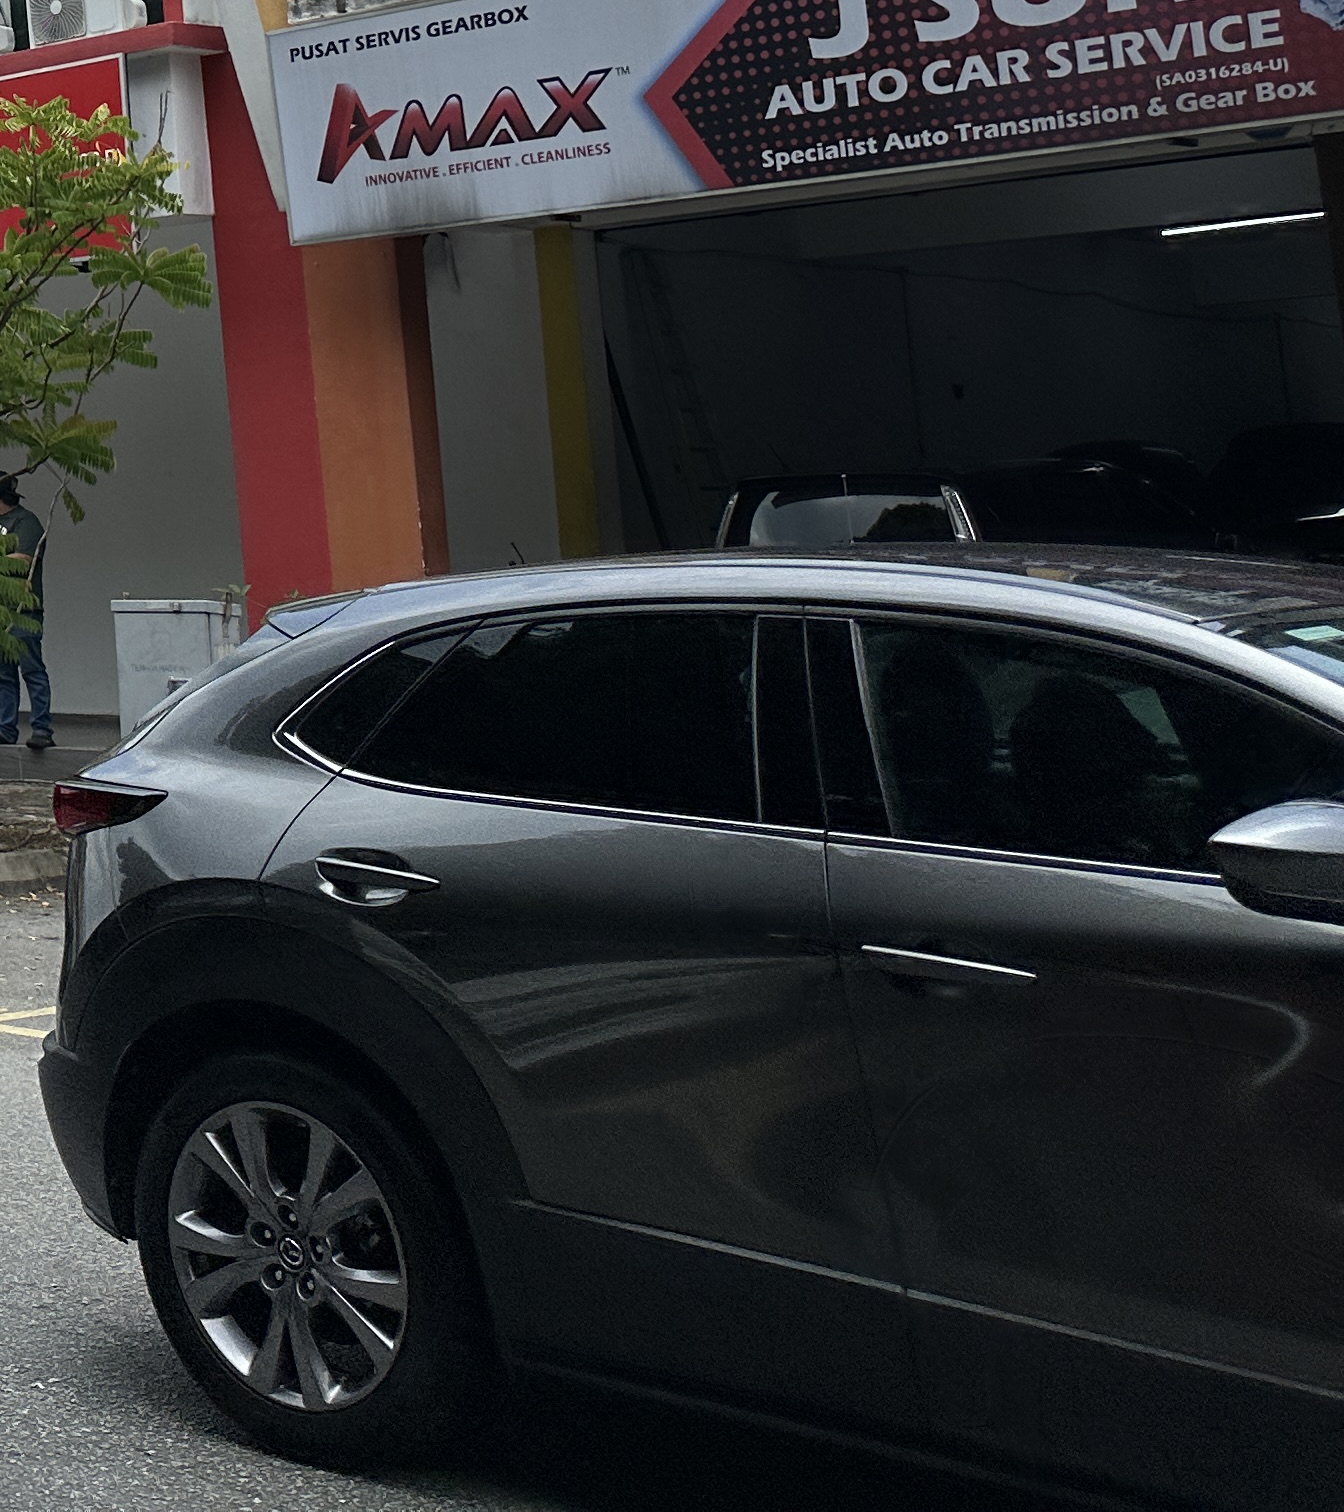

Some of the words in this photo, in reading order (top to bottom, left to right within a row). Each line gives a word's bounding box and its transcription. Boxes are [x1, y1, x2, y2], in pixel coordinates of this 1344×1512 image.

[289, 37, 350, 63] PUSAT
[354, 25, 422, 52] SERVIS
[425, 5, 530, 39] GEARBOX
[764, 67, 909, 120] AUTO
[920, 48, 1031, 96] CAR
[1045, 8, 1286, 79] SERVICE
[1155, 56, 1290, 90] (SA0316284-U)
[316, 67, 613, 185] AMAX
[761, 136, 878, 172] Specialist
[882, 127, 949, 153] Auto
[953, 101, 1140, 144] Transmission
[1146, 96, 1169, 117] &
[1175, 87, 1247, 115] Gear
[1253, 79, 1317, 104] Box
[364, 165, 441, 188] INNOVATIVE
[447, 156, 512, 176] EFFICIENT
[520, 141, 612, 167] CLEANLINESS
